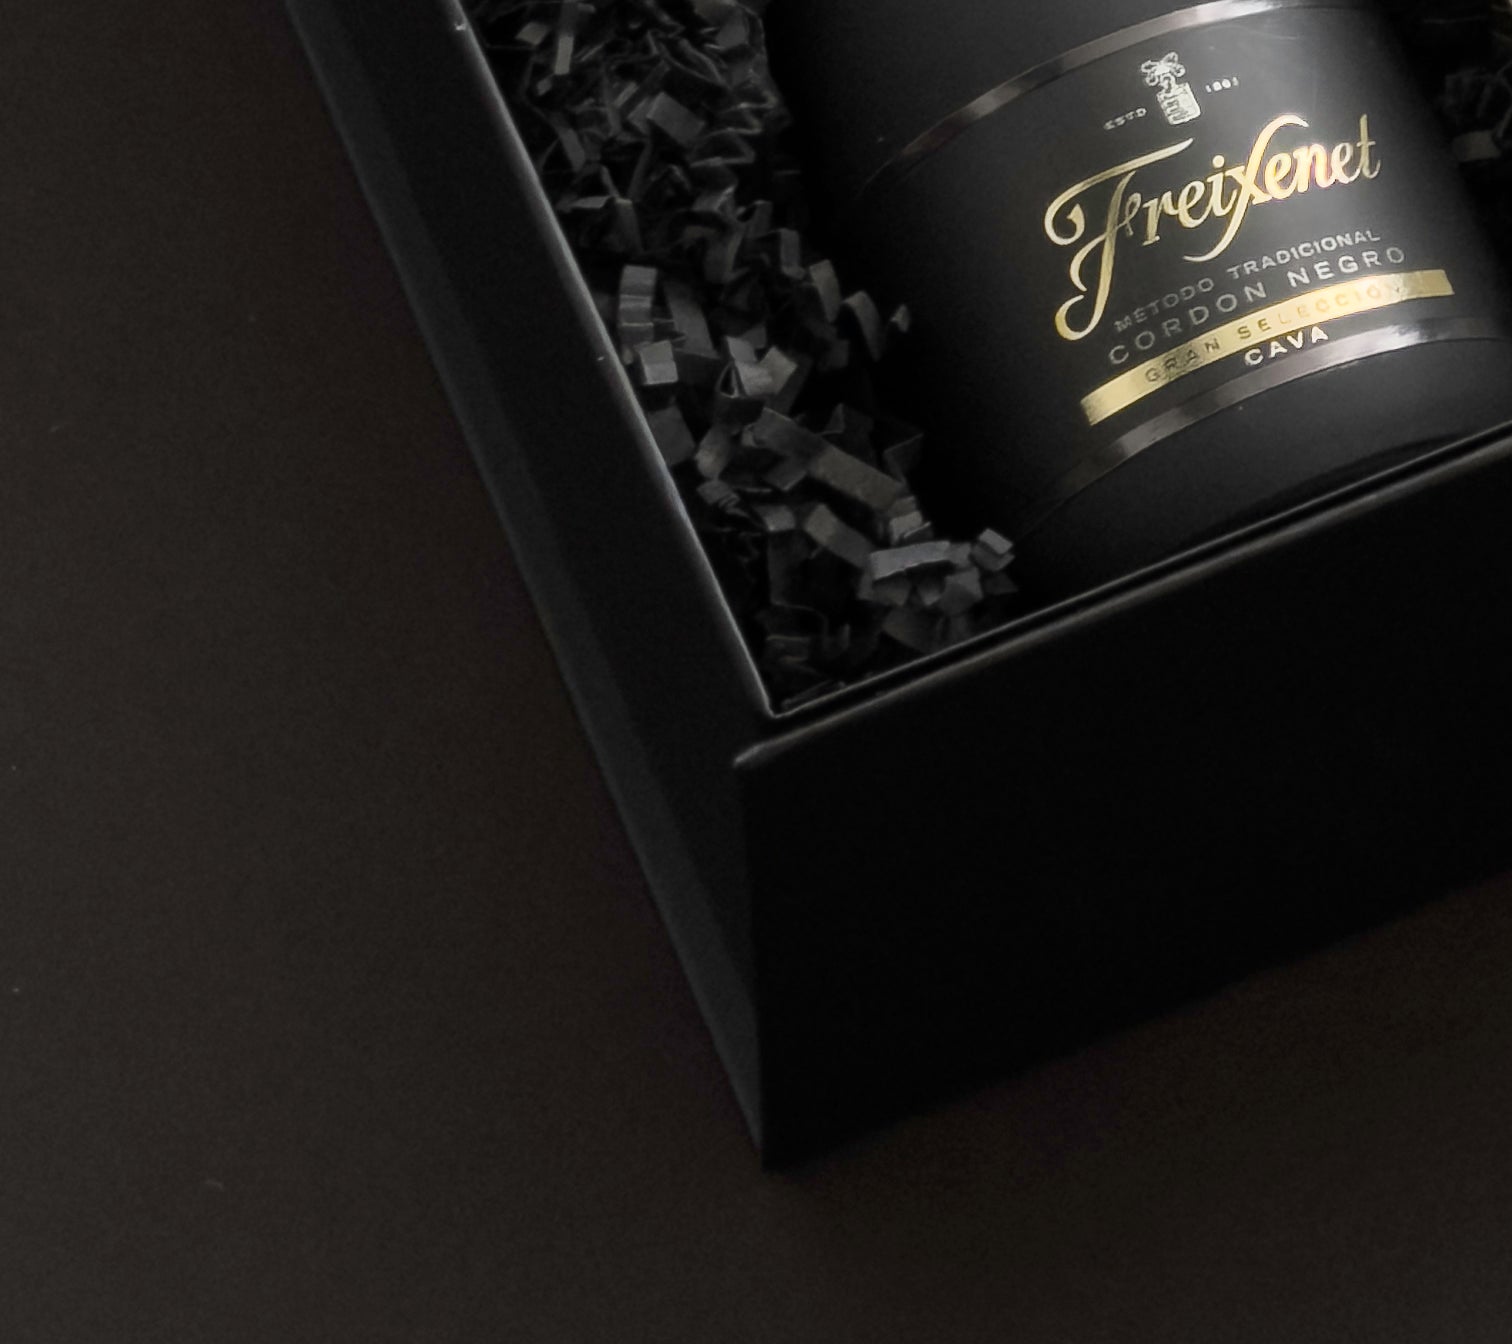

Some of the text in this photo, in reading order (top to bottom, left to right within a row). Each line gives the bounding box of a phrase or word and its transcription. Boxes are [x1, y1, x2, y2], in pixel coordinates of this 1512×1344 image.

[1045, 114, 1381, 341] Freixenet
[1226, 229, 1381, 279] TRADICIONAL
[1108, 247, 1405, 365] CORDON NEGRO
[1145, 339, 1220, 383] GRAN
[1244, 326, 1328, 365] CAVA
